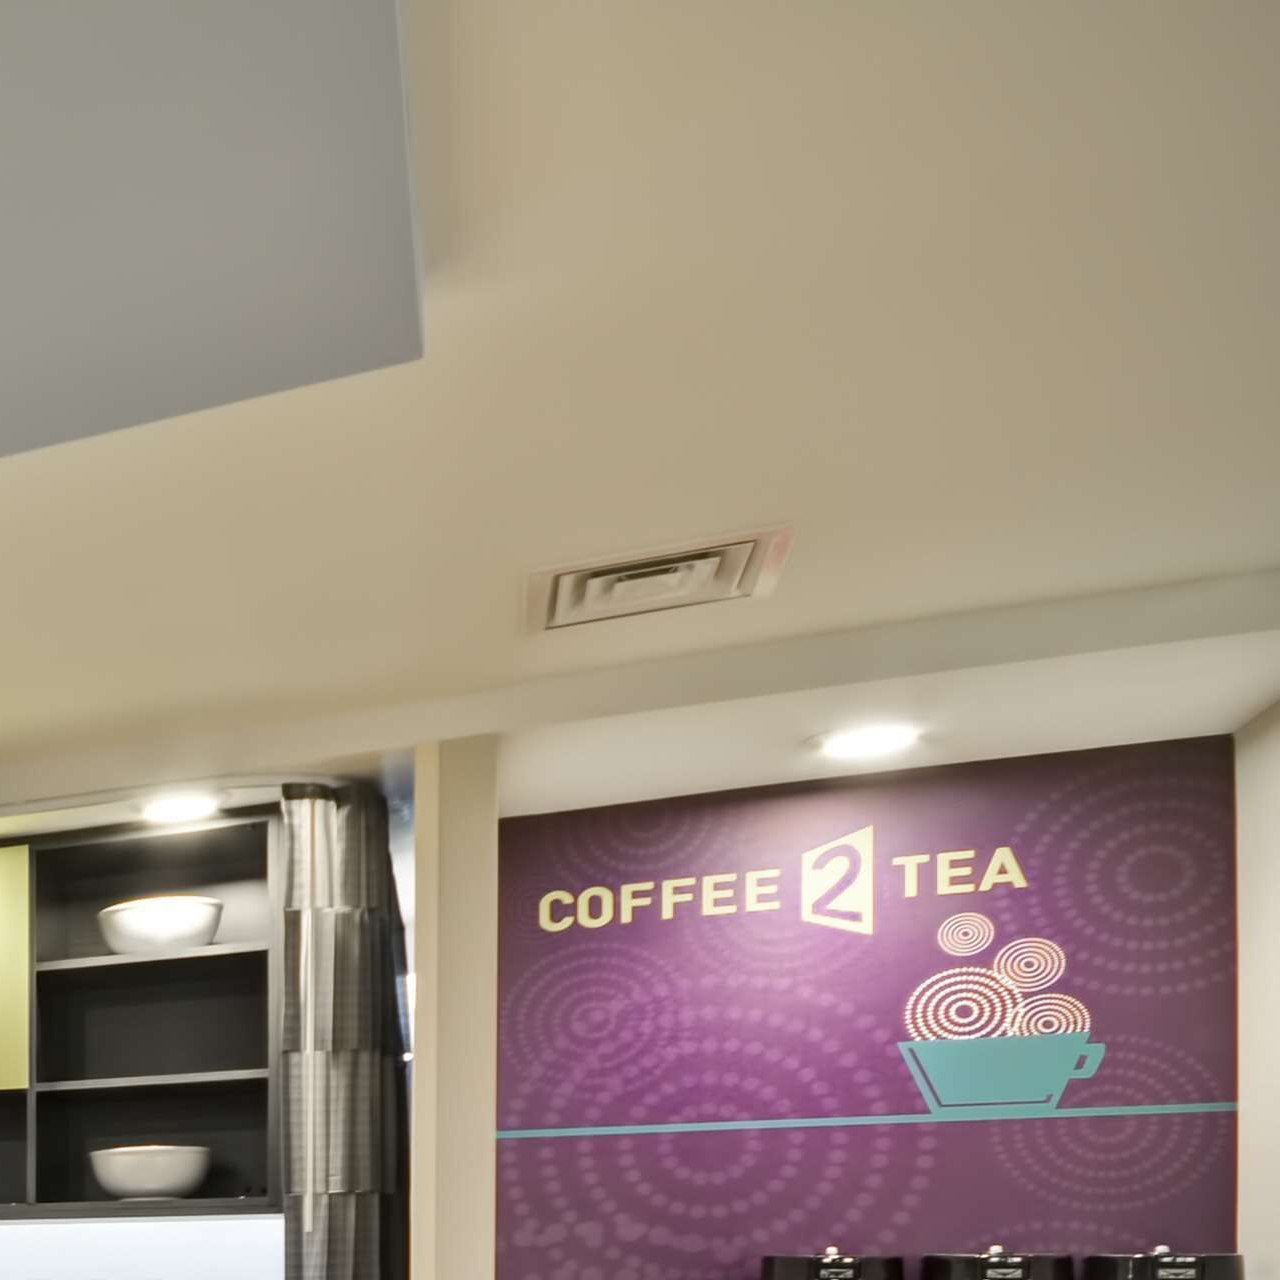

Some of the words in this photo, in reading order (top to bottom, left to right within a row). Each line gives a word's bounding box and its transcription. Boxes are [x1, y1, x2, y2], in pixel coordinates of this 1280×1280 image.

[537, 867, 782, 933] COFFEE
[809, 842, 865, 924] 2
[891, 846, 1028, 898] TEA
